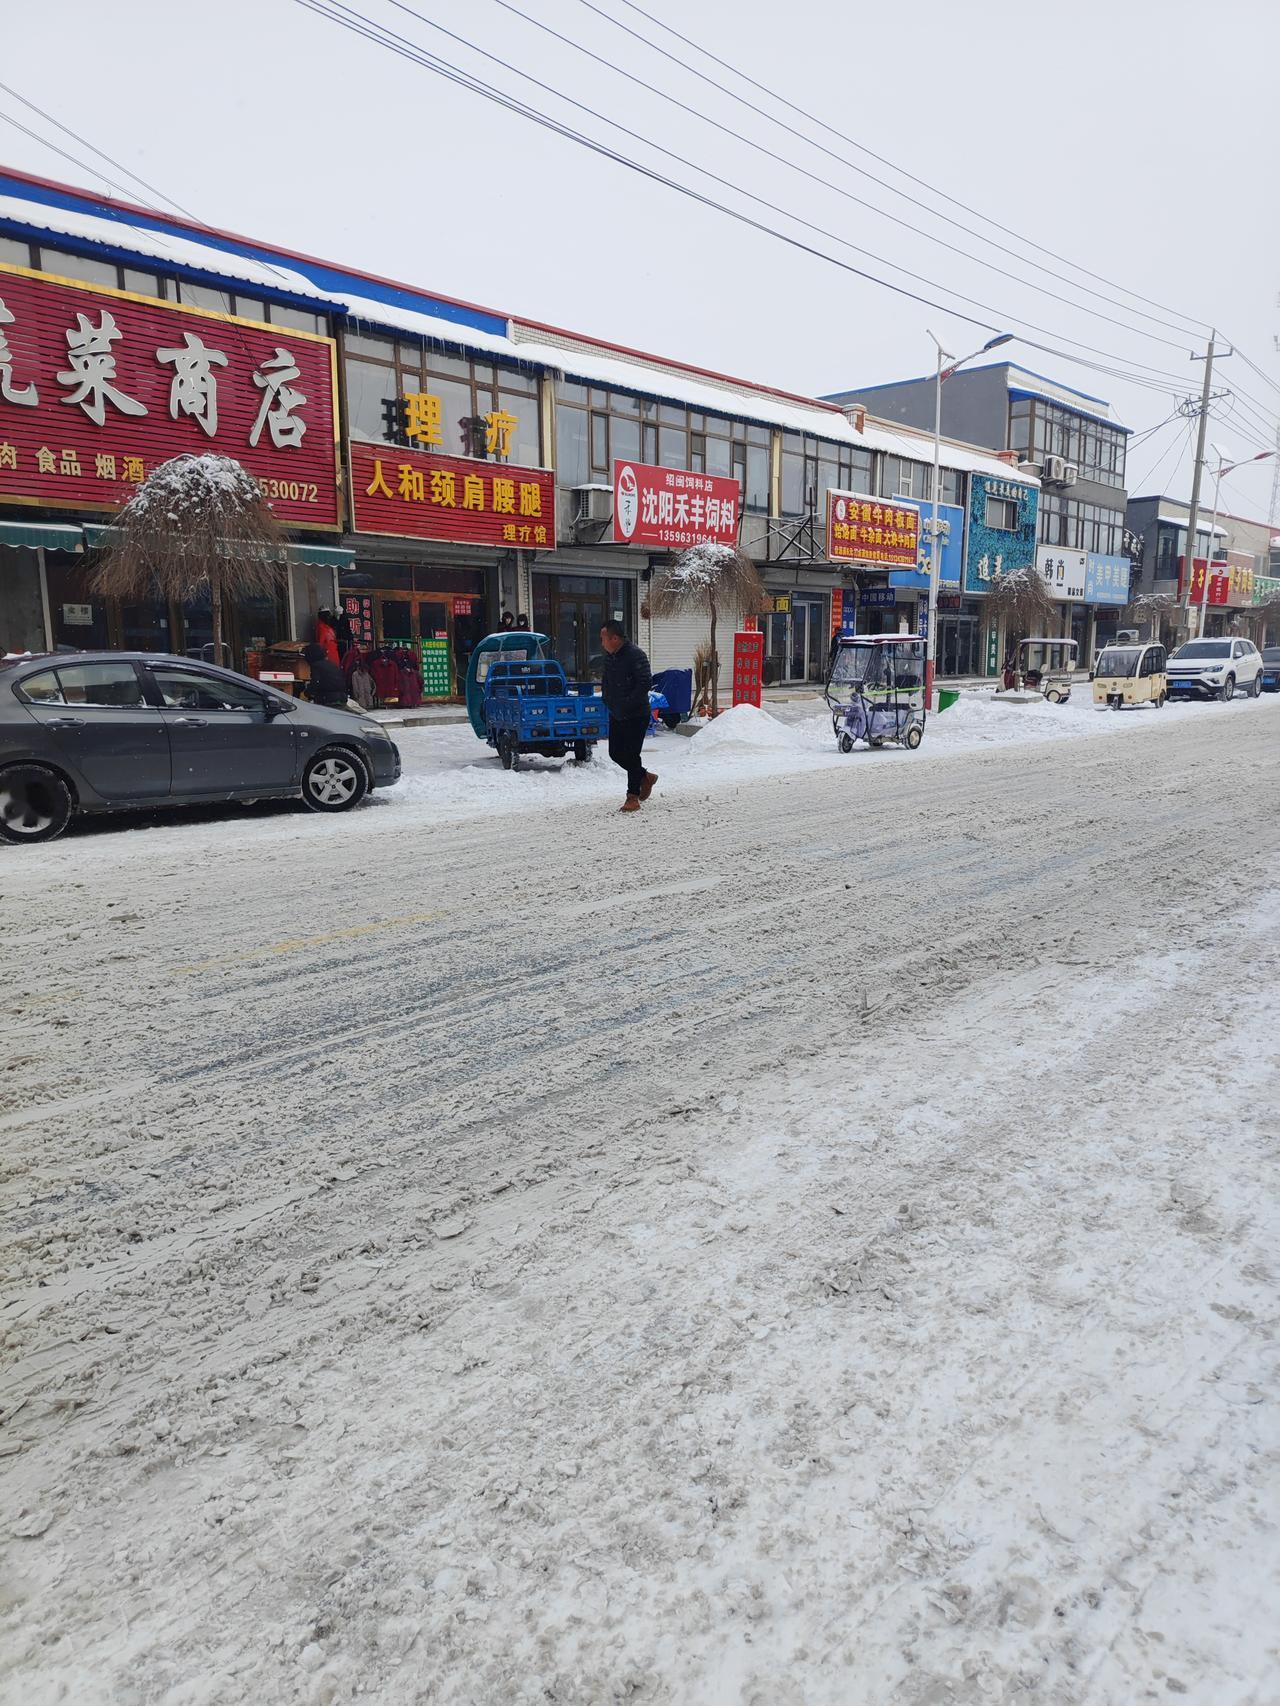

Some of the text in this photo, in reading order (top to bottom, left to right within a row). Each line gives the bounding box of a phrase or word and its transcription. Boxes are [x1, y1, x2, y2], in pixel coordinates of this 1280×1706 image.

[403, 392, 520, 457] 理疗
[35, 446, 82, 477] 食品
[95, 453, 145, 483] 烟酒
[365, 459, 544, 518] 人和颈肩腰腿
[641, 487, 736, 534] 沈阳禾丰饲料
[502, 524, 548, 545] 理疗馆
[861, 592, 895, 603] 中国移动
